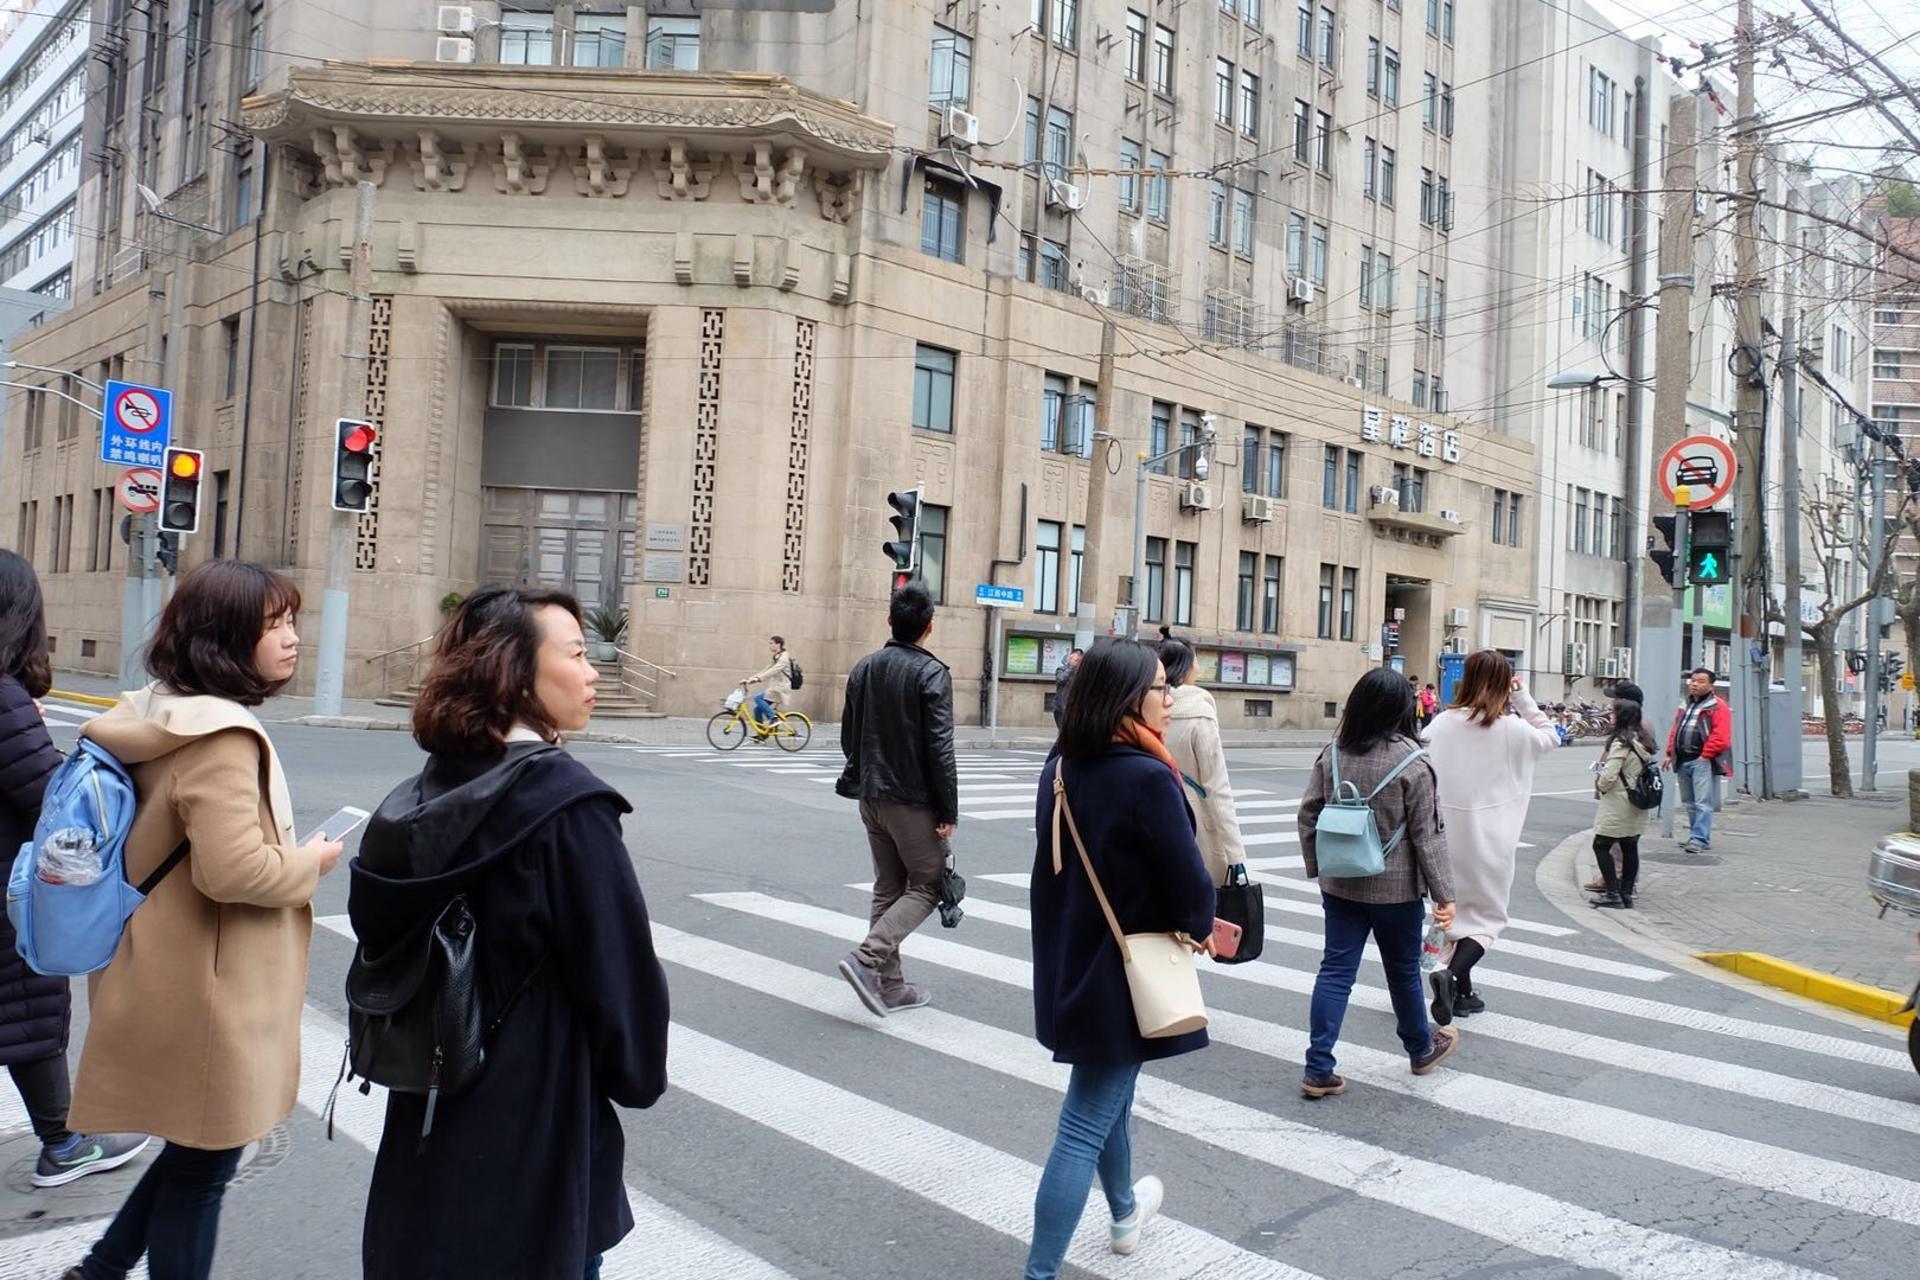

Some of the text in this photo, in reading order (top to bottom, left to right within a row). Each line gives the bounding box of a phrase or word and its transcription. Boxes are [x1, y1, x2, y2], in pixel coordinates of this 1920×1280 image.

[1362, 404, 1459, 463] 星程酒店
[111, 434, 162, 452] 外环线内
[110, 448, 162, 465] 禁鸣喇叭
